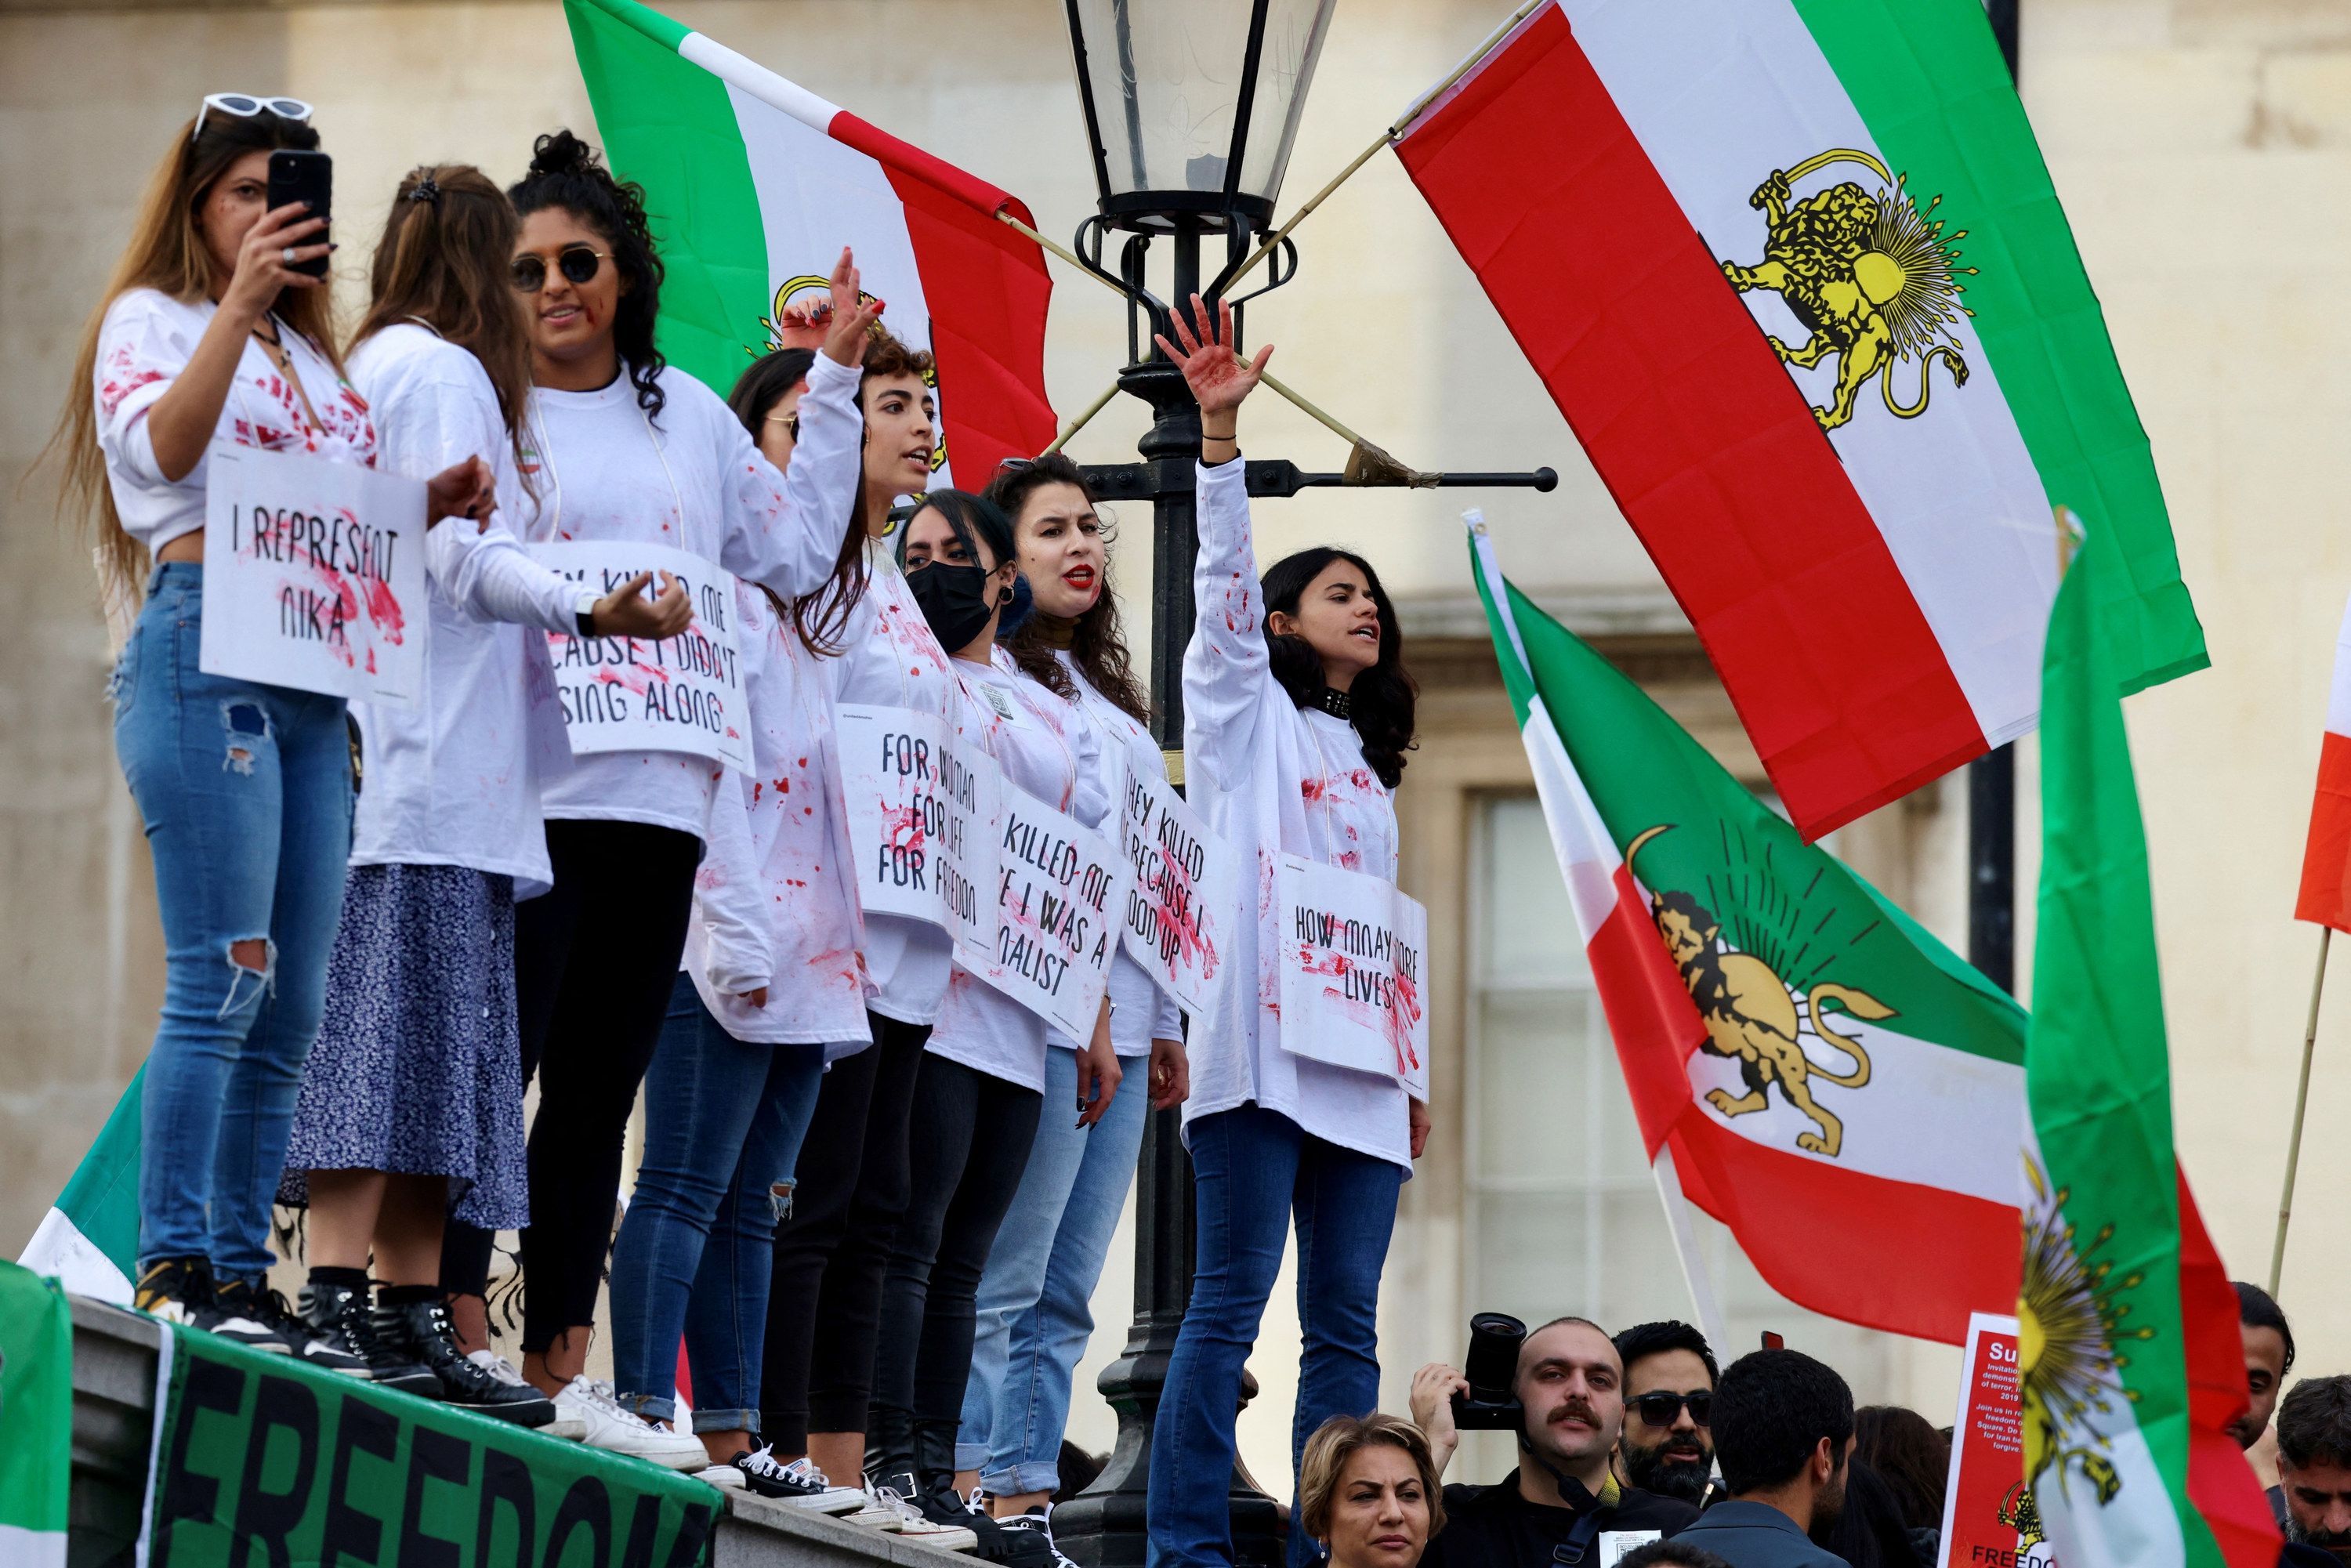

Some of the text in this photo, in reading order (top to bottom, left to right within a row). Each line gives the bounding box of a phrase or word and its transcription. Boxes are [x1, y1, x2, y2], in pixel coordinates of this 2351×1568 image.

[232, 504, 398, 583] I REPRESENT
[281, 586, 344, 646] NIKA
[701, 584, 726, 632] ME
[675, 632, 736, 689] DIDN'T
[558, 679, 628, 725] SING
[645, 680, 722, 733] ALONG
[882, 733, 976, 814] FOR WOMAN
[912, 793, 964, 861] FOR LIFE
[1125, 763, 1204, 883] THEY KILLED
[878, 843, 926, 891] FOR
[1003, 813, 1114, 913] KILLED ME
[1020, 882, 1032, 917] I
[1040, 890, 1089, 954] WAS
[1090, 931, 1108, 970] A
[1128, 889, 1181, 968] OOD UP
[1195, 904, 1204, 938] I
[1295, 905, 1335, 948] HOW
[1976, 1403, 1993, 1412] Join
[1991, 1382, 2013, 1392] terror,
[2000, 1392, 2019, 1402] 2019
[1976, 1421, 2005, 1432] Square.
[2007, 1426, 2018, 1435] Do
[1985, 1413, 2016, 1425] freedom
[1996, 1433, 2011, 1442] Iran
[1993, 1442, 2021, 1453] forgive.
